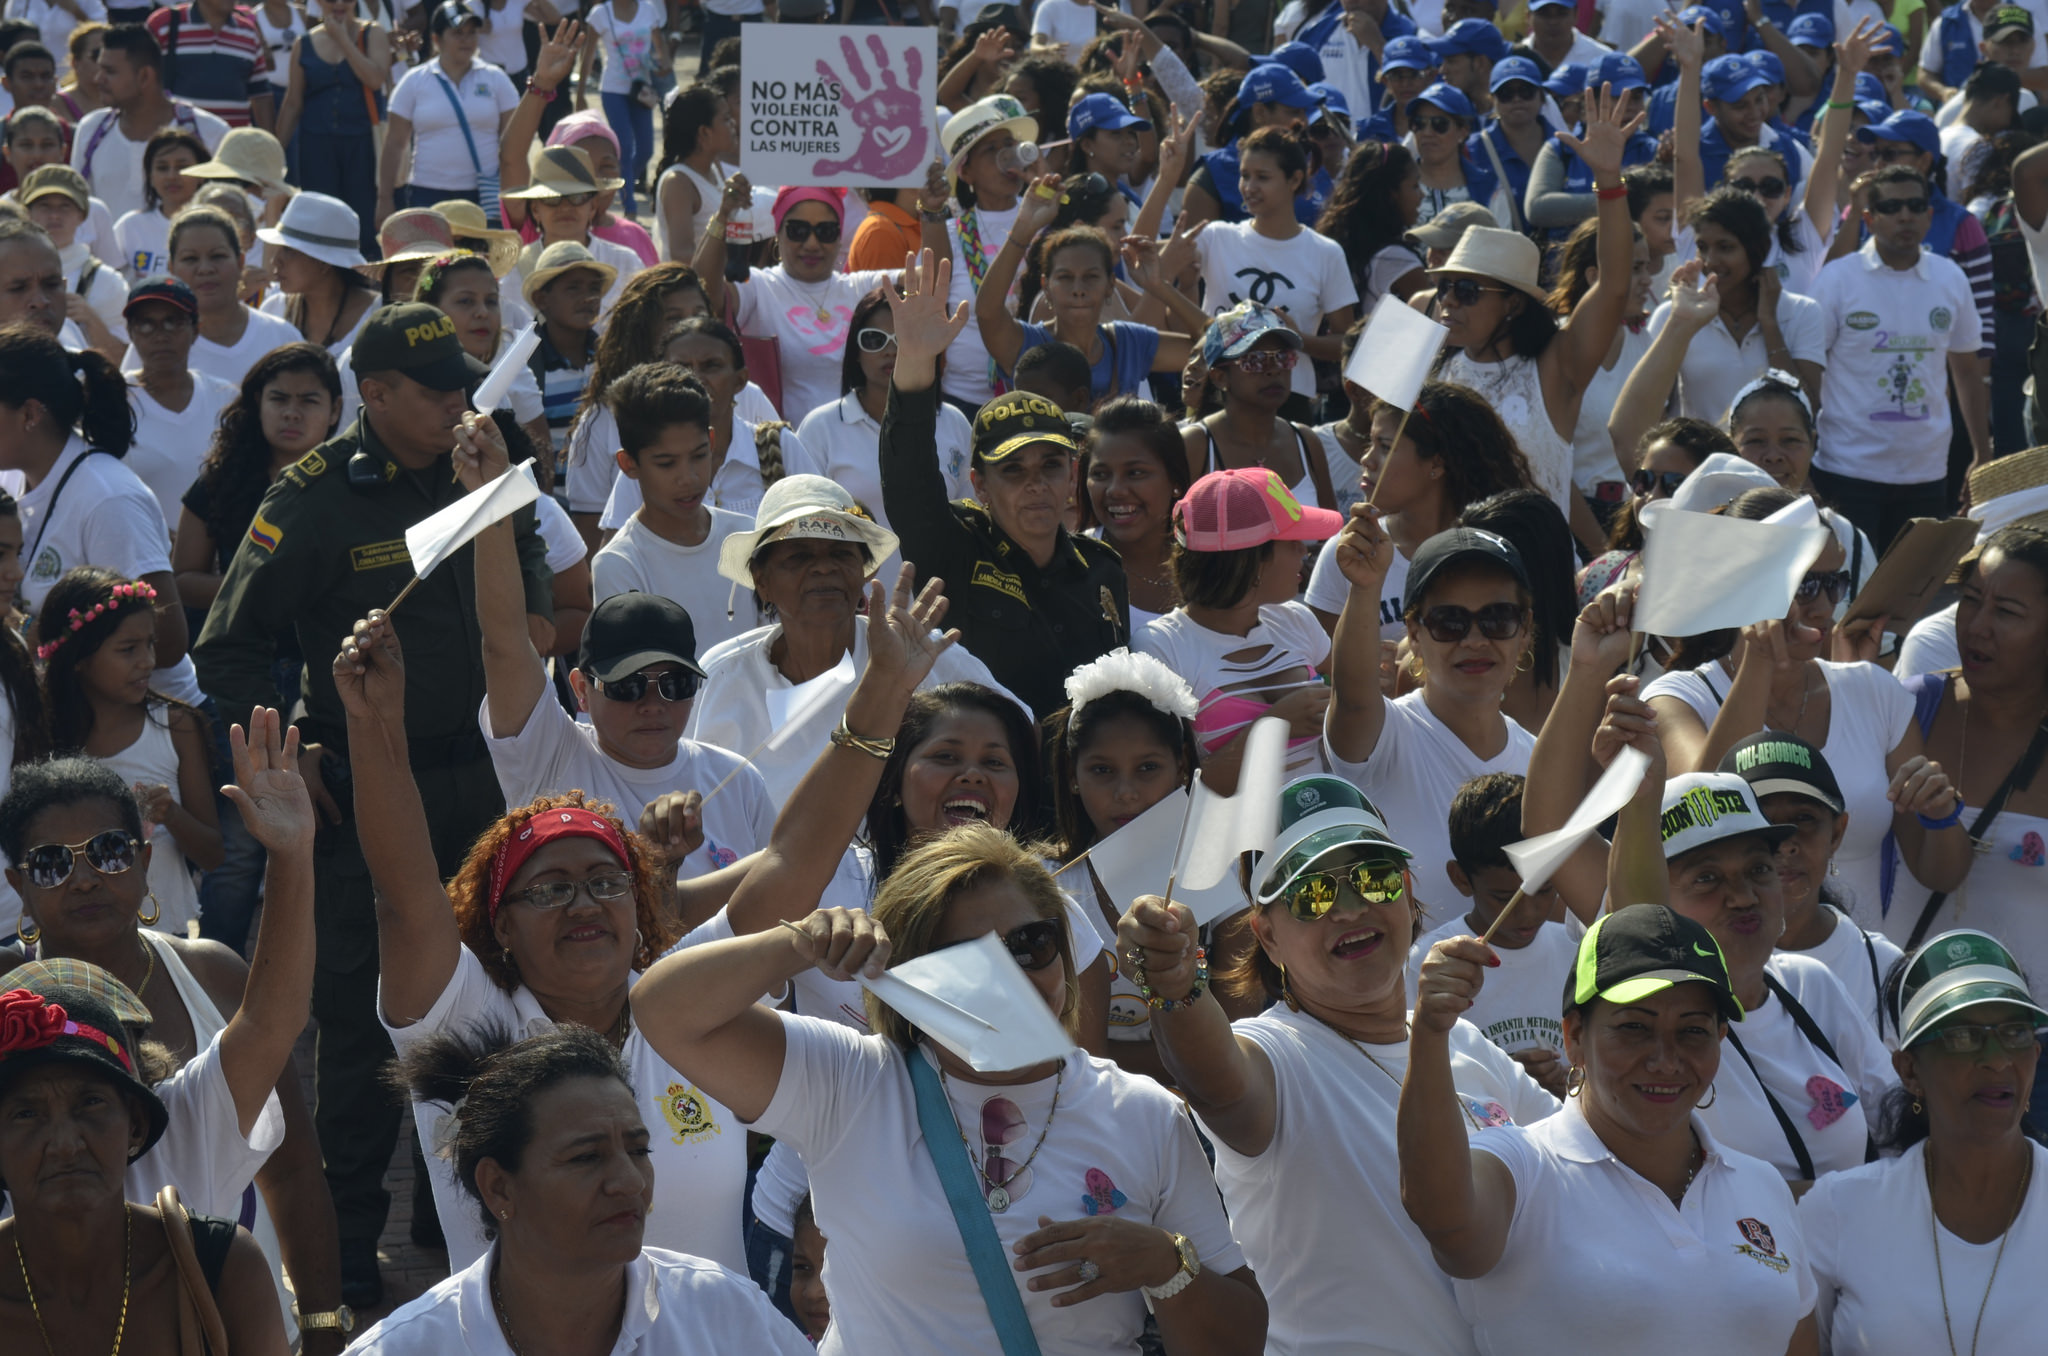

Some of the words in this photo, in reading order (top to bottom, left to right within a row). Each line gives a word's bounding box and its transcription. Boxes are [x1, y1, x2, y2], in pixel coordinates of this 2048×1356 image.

[752, 81, 787, 100] NO
[794, 76, 841, 101] MÁS
[751, 102, 839, 117] VIOLENCIA
[750, 119, 839, 137] CONTRA
[750, 140, 777, 152] LAS
[780, 141, 840, 156] MUJERES
[980, 398, 1066, 431] POLICIA
[798, 520, 846, 540] RAFA
[1735, 741, 1812, 774] POLI-AEROBICOS
[1488, 1017, 1523, 1036] INFANTIL
[1503, 1029, 1536, 1044] SANTA
